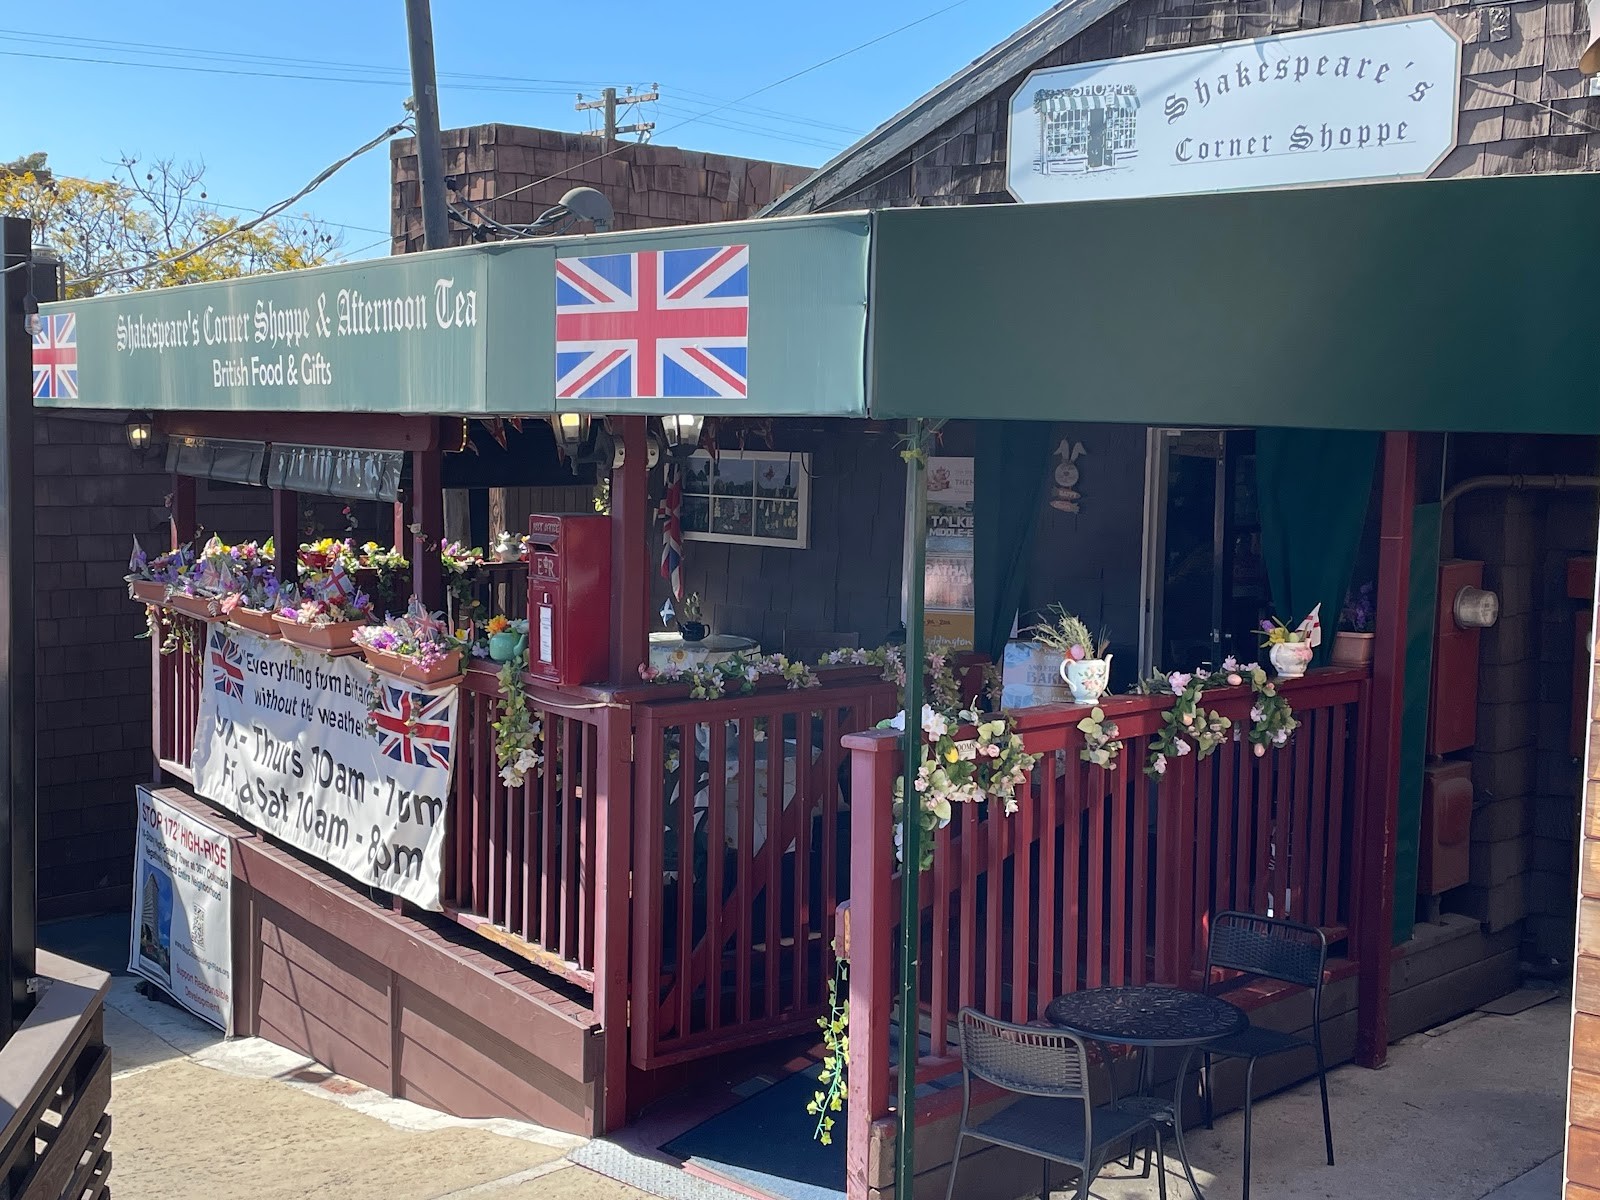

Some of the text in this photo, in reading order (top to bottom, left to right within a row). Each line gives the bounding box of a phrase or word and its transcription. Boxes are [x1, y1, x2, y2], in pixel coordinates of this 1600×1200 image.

[1163, 54, 1435, 125] Shakespeare's
[1174, 119, 1410, 163] Corner Shoppe
[116, 276, 478, 356] Shakespeare's Corner Shoppe & Afternoon Tea
[212, 352, 332, 388] British Food & Gifts
[254, 687, 298, 717] without
[301, 698, 314, 722] the
[315, 666, 342, 694] from
[253, 725, 304, 779] Thurs
[312, 746, 365, 804] 10am
[142, 802, 162, 830] STOP
[181, 825, 227, 868] HIGH-RISE
[256, 776, 290, 822] Sat
[296, 791, 349, 850] 10am
[368, 824, 423, 881] 8pm
